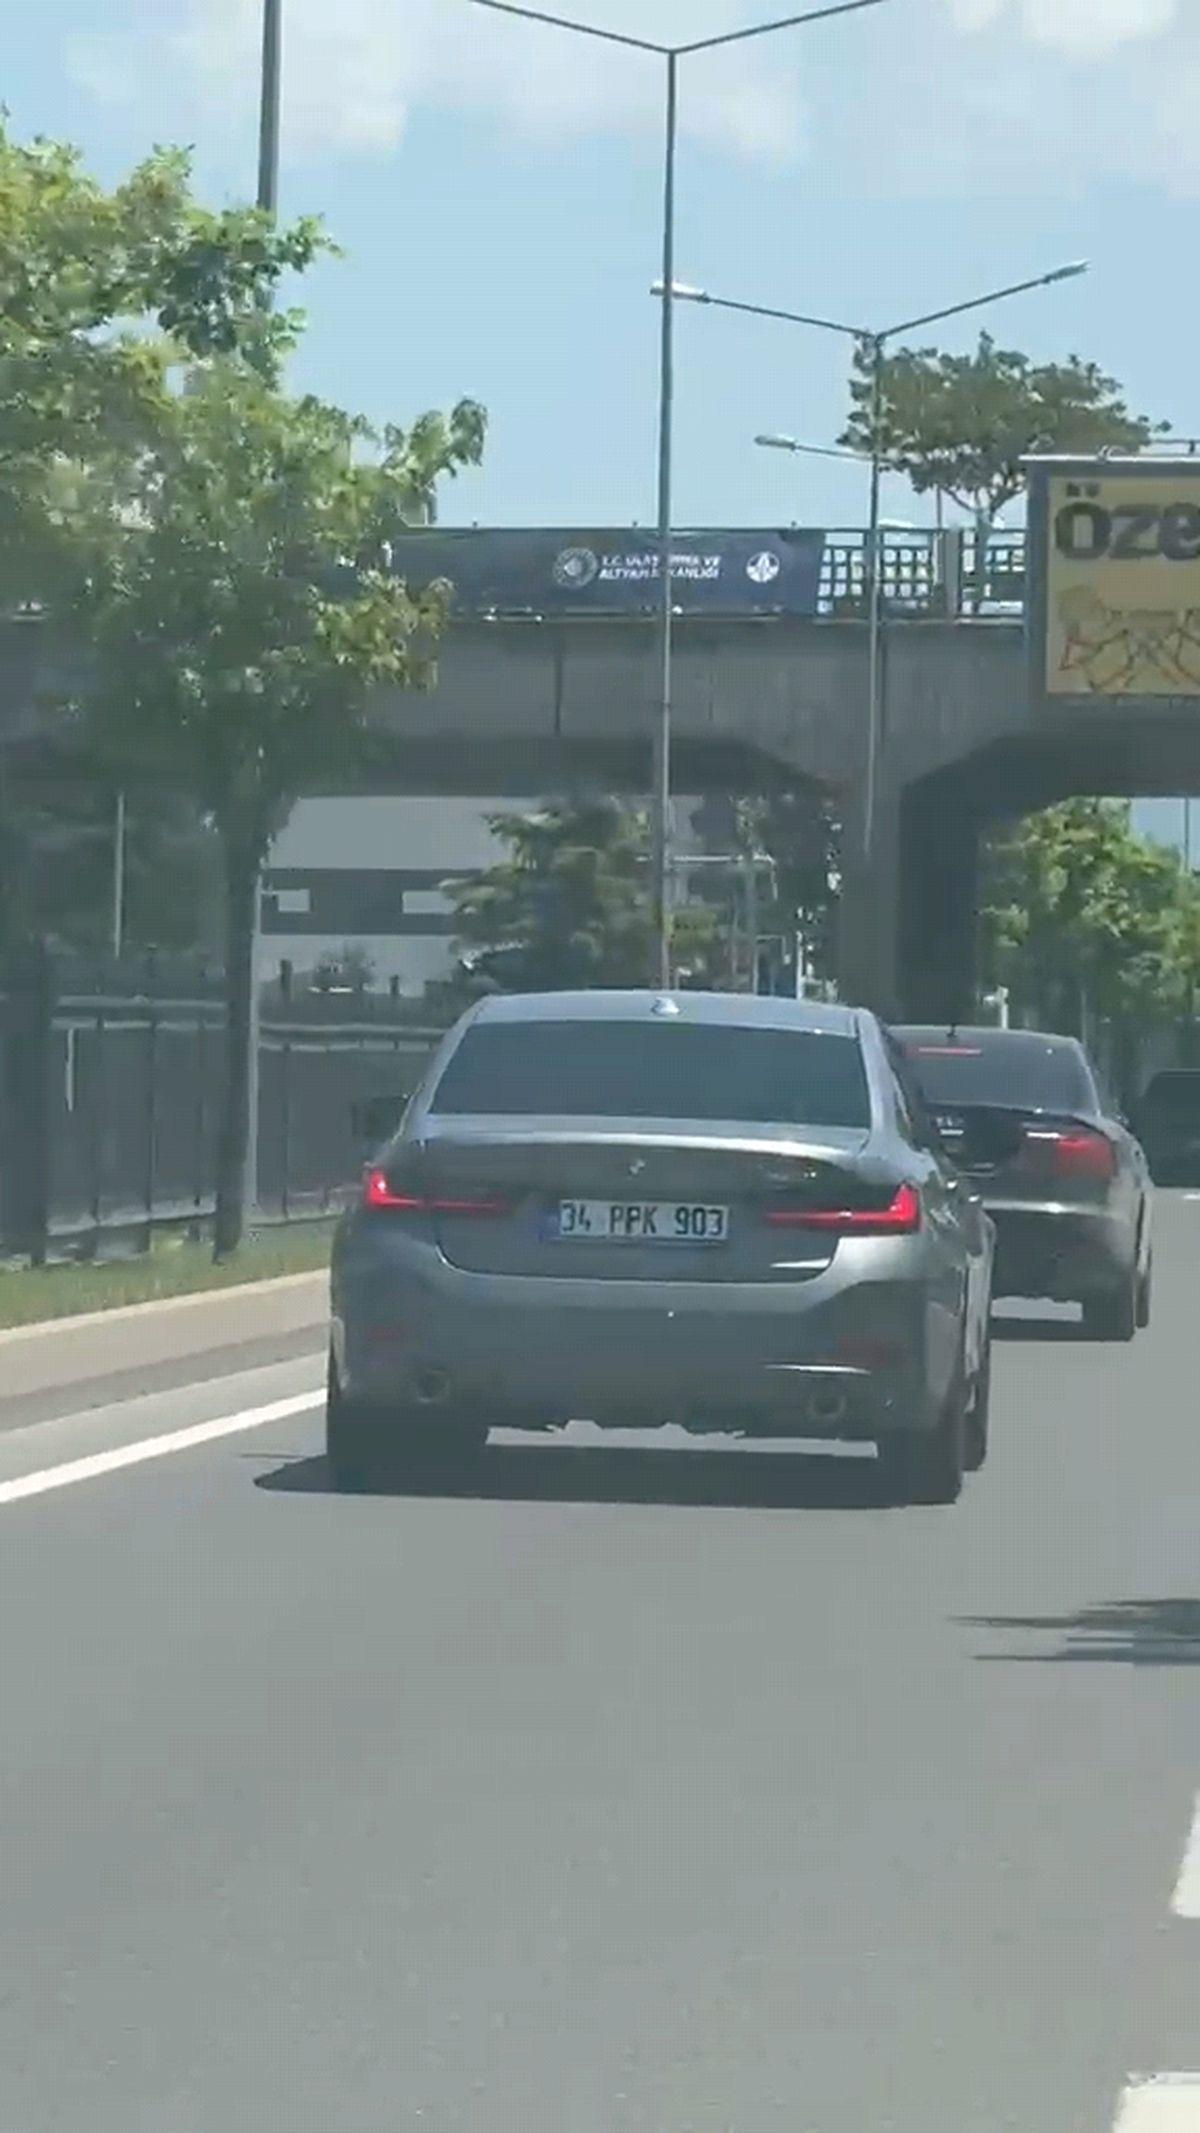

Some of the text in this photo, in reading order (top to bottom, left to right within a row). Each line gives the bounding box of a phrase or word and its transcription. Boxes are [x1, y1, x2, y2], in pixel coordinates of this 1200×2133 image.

[561, 1202, 723, 1236] 34 PPK 903
